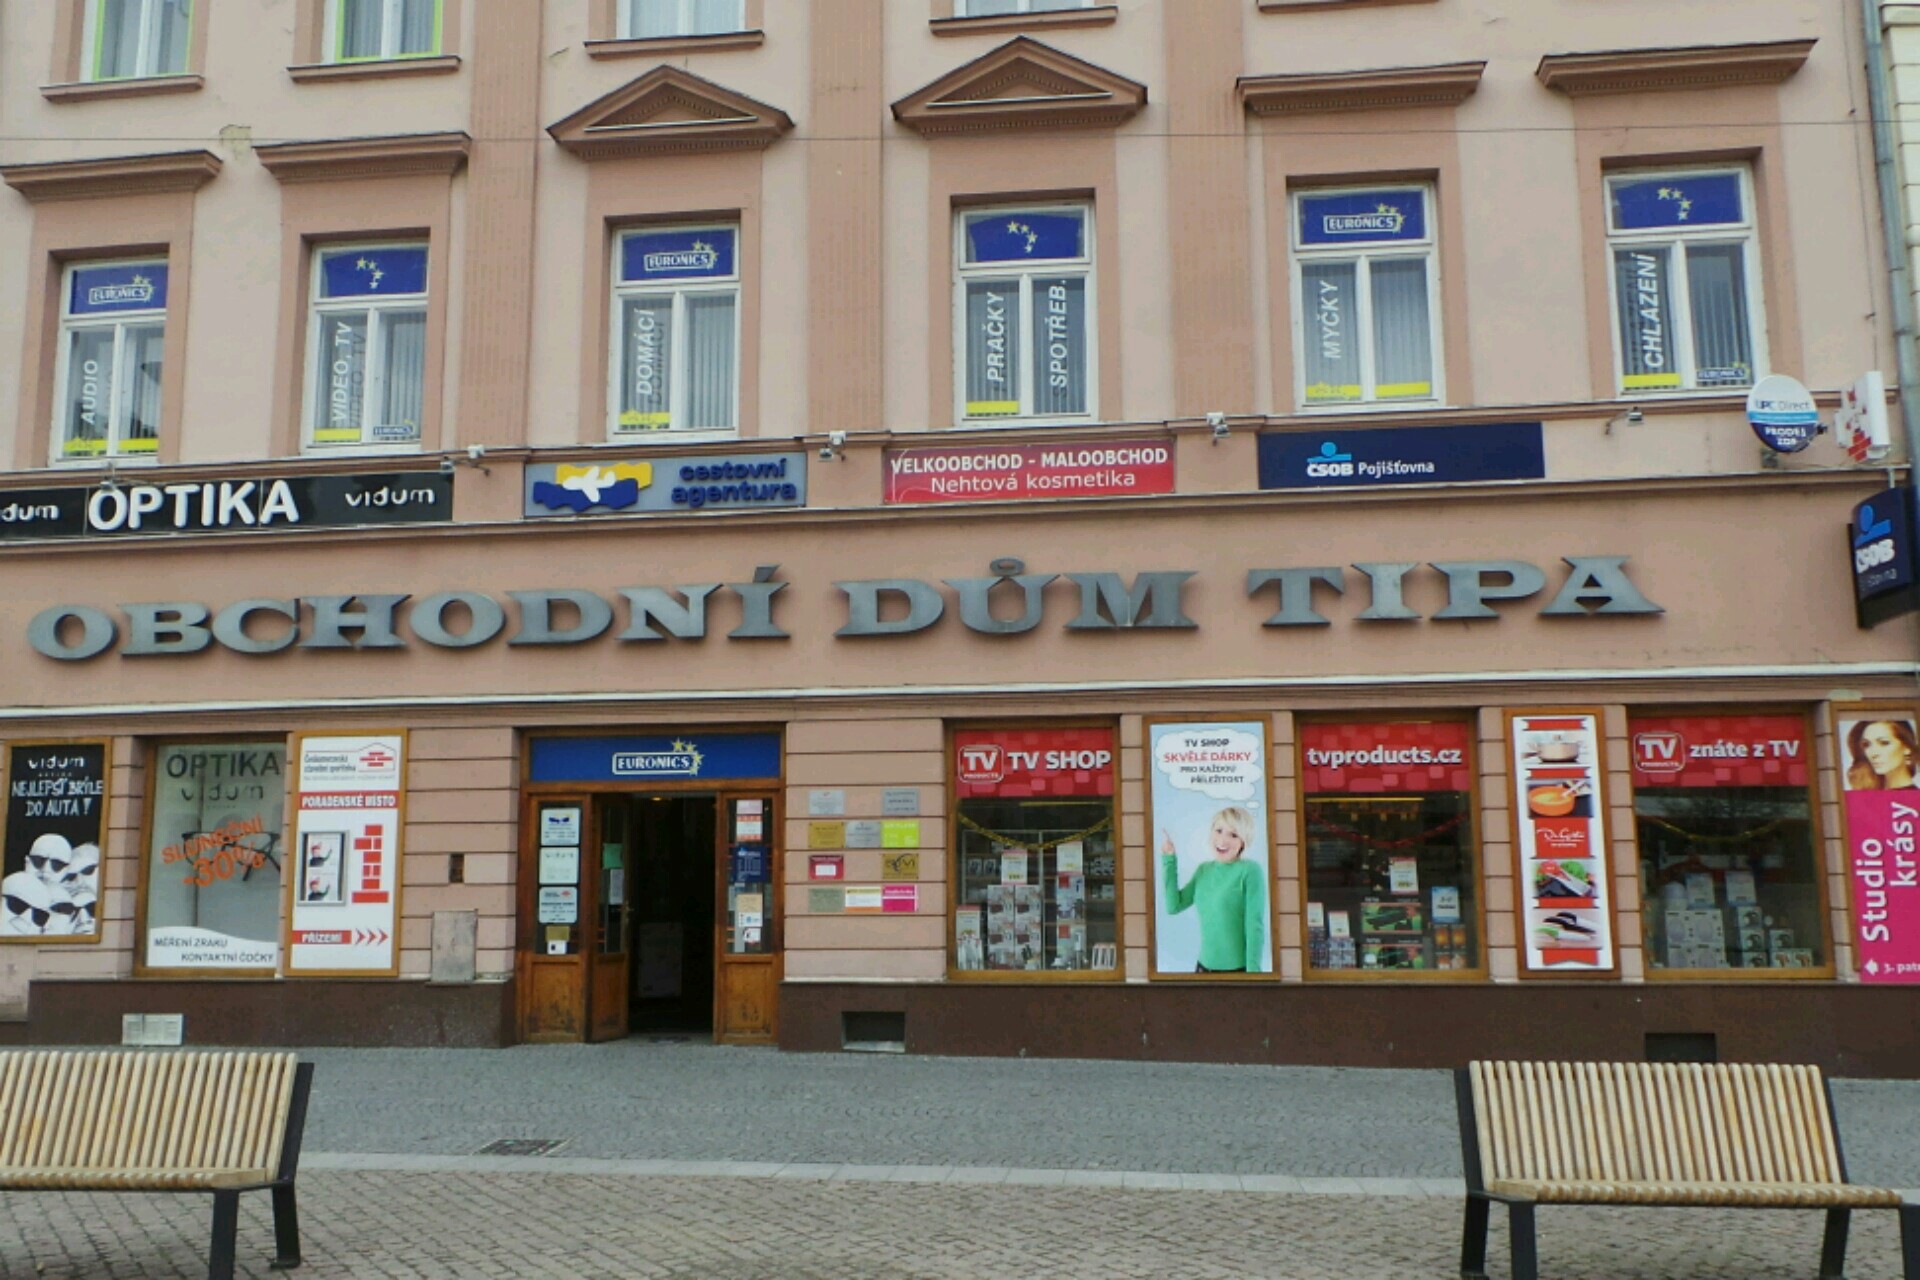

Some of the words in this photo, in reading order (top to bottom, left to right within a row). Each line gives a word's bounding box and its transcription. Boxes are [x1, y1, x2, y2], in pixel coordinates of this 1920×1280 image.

[1329, 214, 1395, 230] EURONICS
[649, 252, 710, 268] EURONICS
[1317, 280, 1341, 358] MYČKY
[1631, 252, 1664, 368] CHLAZENÍ
[335, 321, 353, 346] TV
[982, 291, 1004, 382] PRAČKY
[1045, 279, 1067, 388] SPOTŘEB.
[633, 308, 655, 394] DOMÁCÍ
[81, 359, 99, 426] AUDIO
[331, 355, 352, 421] VIDEO,
[1778, 400, 1811, 410] Direct
[679, 458, 787, 482] cestovní
[890, 454, 1023, 474] VELKOOBCHOD
[1041, 448, 1168, 468] MALOOBCHOD
[1306, 462, 1354, 477] ČSOB
[1358, 460, 1435, 479] Pojišťovna
[671, 481, 797, 506] agentura
[931, 475, 1018, 494] Nehtová
[1026, 471, 1136, 490] kosmetika
[0, 503, 59, 521] dum
[88, 480, 299, 530] OPTIKA
[345, 486, 435, 508] vidum
[26, 564, 790, 661] OBCHODNÍ
[830, 556, 1199, 640] DŮM
[1248, 555, 1665, 629] TIPA
[1185, 739, 1198, 747] TV
[1201, 739, 1230, 747] SHOP
[1639, 739, 1677, 759] TV
[1690, 739, 1749, 758] znáte
[1753, 744, 1765, 758] z
[1768, 740, 1799, 757] TV
[166, 752, 281, 778] OPTIKA
[617, 756, 690, 770] EURONICS
[963, 752, 998, 771] TV
[1007, 752, 1040, 770] TV
[1045, 750, 1112, 769] SHOP
[1163, 751, 1208, 763] SKVĚLÉ
[1210, 749, 1252, 761] DÁRKY
[1307, 744, 1463, 769] tvproducts.cz
[25, 801, 43, 816] DO
[45, 799, 80, 816] AUTA
[1886, 801, 1919, 887] krásy
[183, 843, 266, 887] -30%
[1856, 838, 1889, 941] Studio
[154, 936, 193, 948] MĚŘENÍ
[194, 937, 228, 948] ZRAKU
[181, 952, 238, 962] KONTAKTNÍ
[239, 952, 274, 963] ČOČKY
